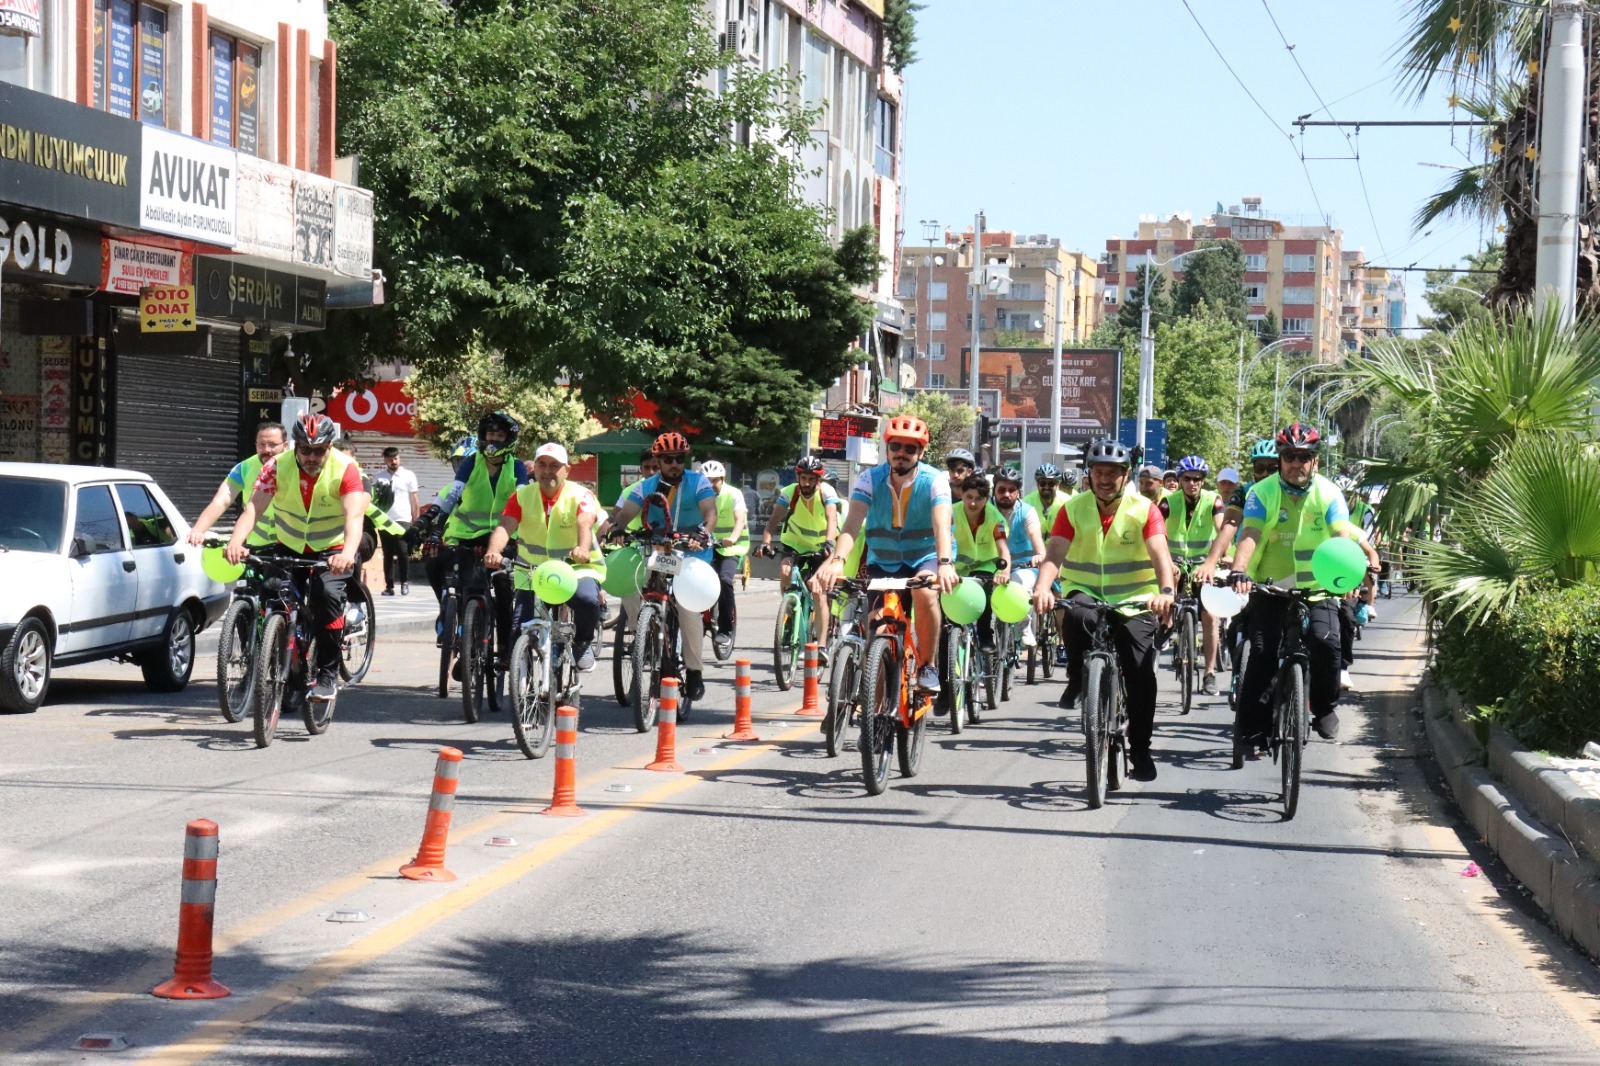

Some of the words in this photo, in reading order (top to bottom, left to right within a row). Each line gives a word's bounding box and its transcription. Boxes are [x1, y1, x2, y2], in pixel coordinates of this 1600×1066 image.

[34, 132, 128, 187] KUYUMCULUK
[149, 150, 230, 210] AVUKAT
[145, 204, 176, 224] Abdülkadir
[146, 251, 176, 268] RESTAURANT
[144, 289, 189, 300] FOTO
[228, 275, 282, 309] SERDAR
[145, 303, 189, 315] ONAT
[1042, 376, 1079, 387] GLUNSİZ
[1080, 377, 1096, 387] KAFE
[251, 391, 279, 400] SERDAR
